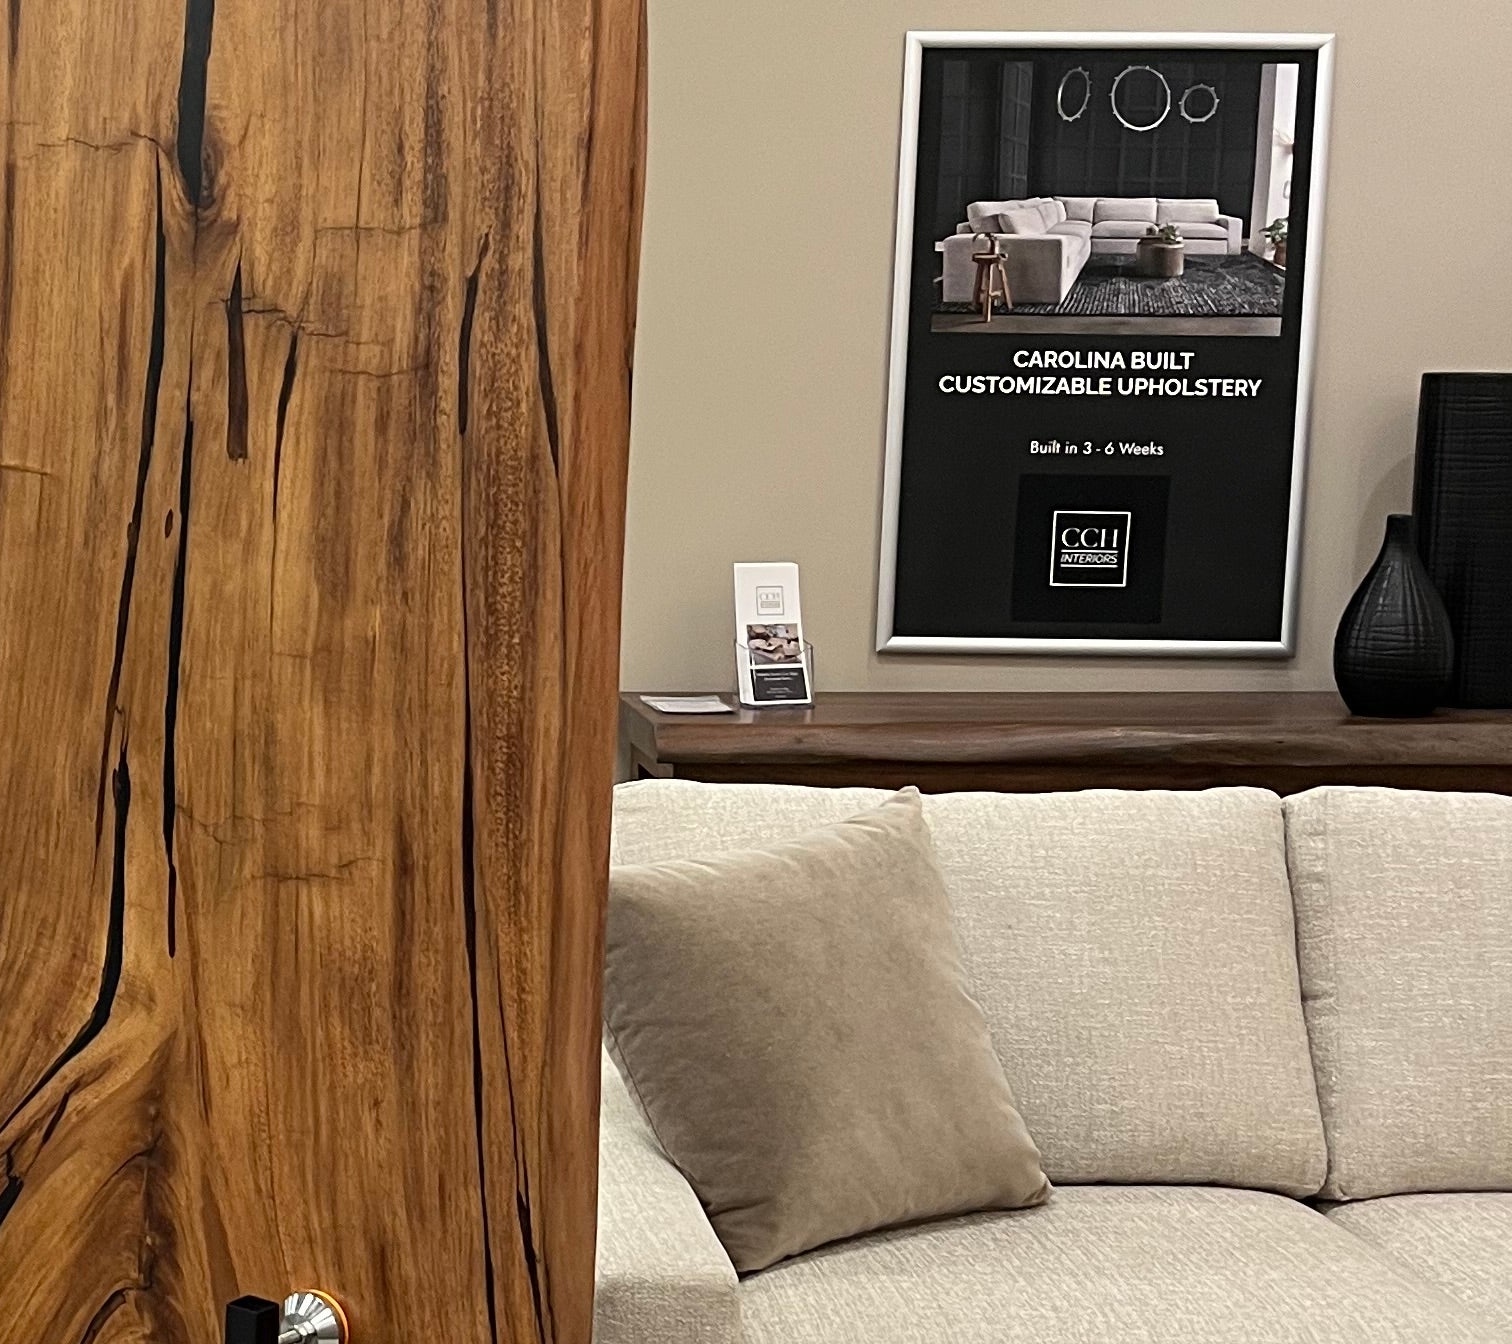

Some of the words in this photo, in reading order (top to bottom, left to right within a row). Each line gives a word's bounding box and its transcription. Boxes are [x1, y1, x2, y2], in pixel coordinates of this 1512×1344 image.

[1013, 350, 1126, 370] CAROLINA
[1131, 351, 1195, 370] BUILT
[938, 375, 1112, 395] CUSTOMIZABLE
[1118, 377, 1263, 397] UPHOLSTERY
[1030, 440, 1061, 454] Built
[1064, 441, 1078, 454] in
[1082, 441, 1093, 455] 3
[1104, 441, 1115, 455] 6
[1118, 441, 1164, 456] Weeks
[1061, 527, 1119, 548] CCH
[1060, 553, 1119, 566] INTERIORS
